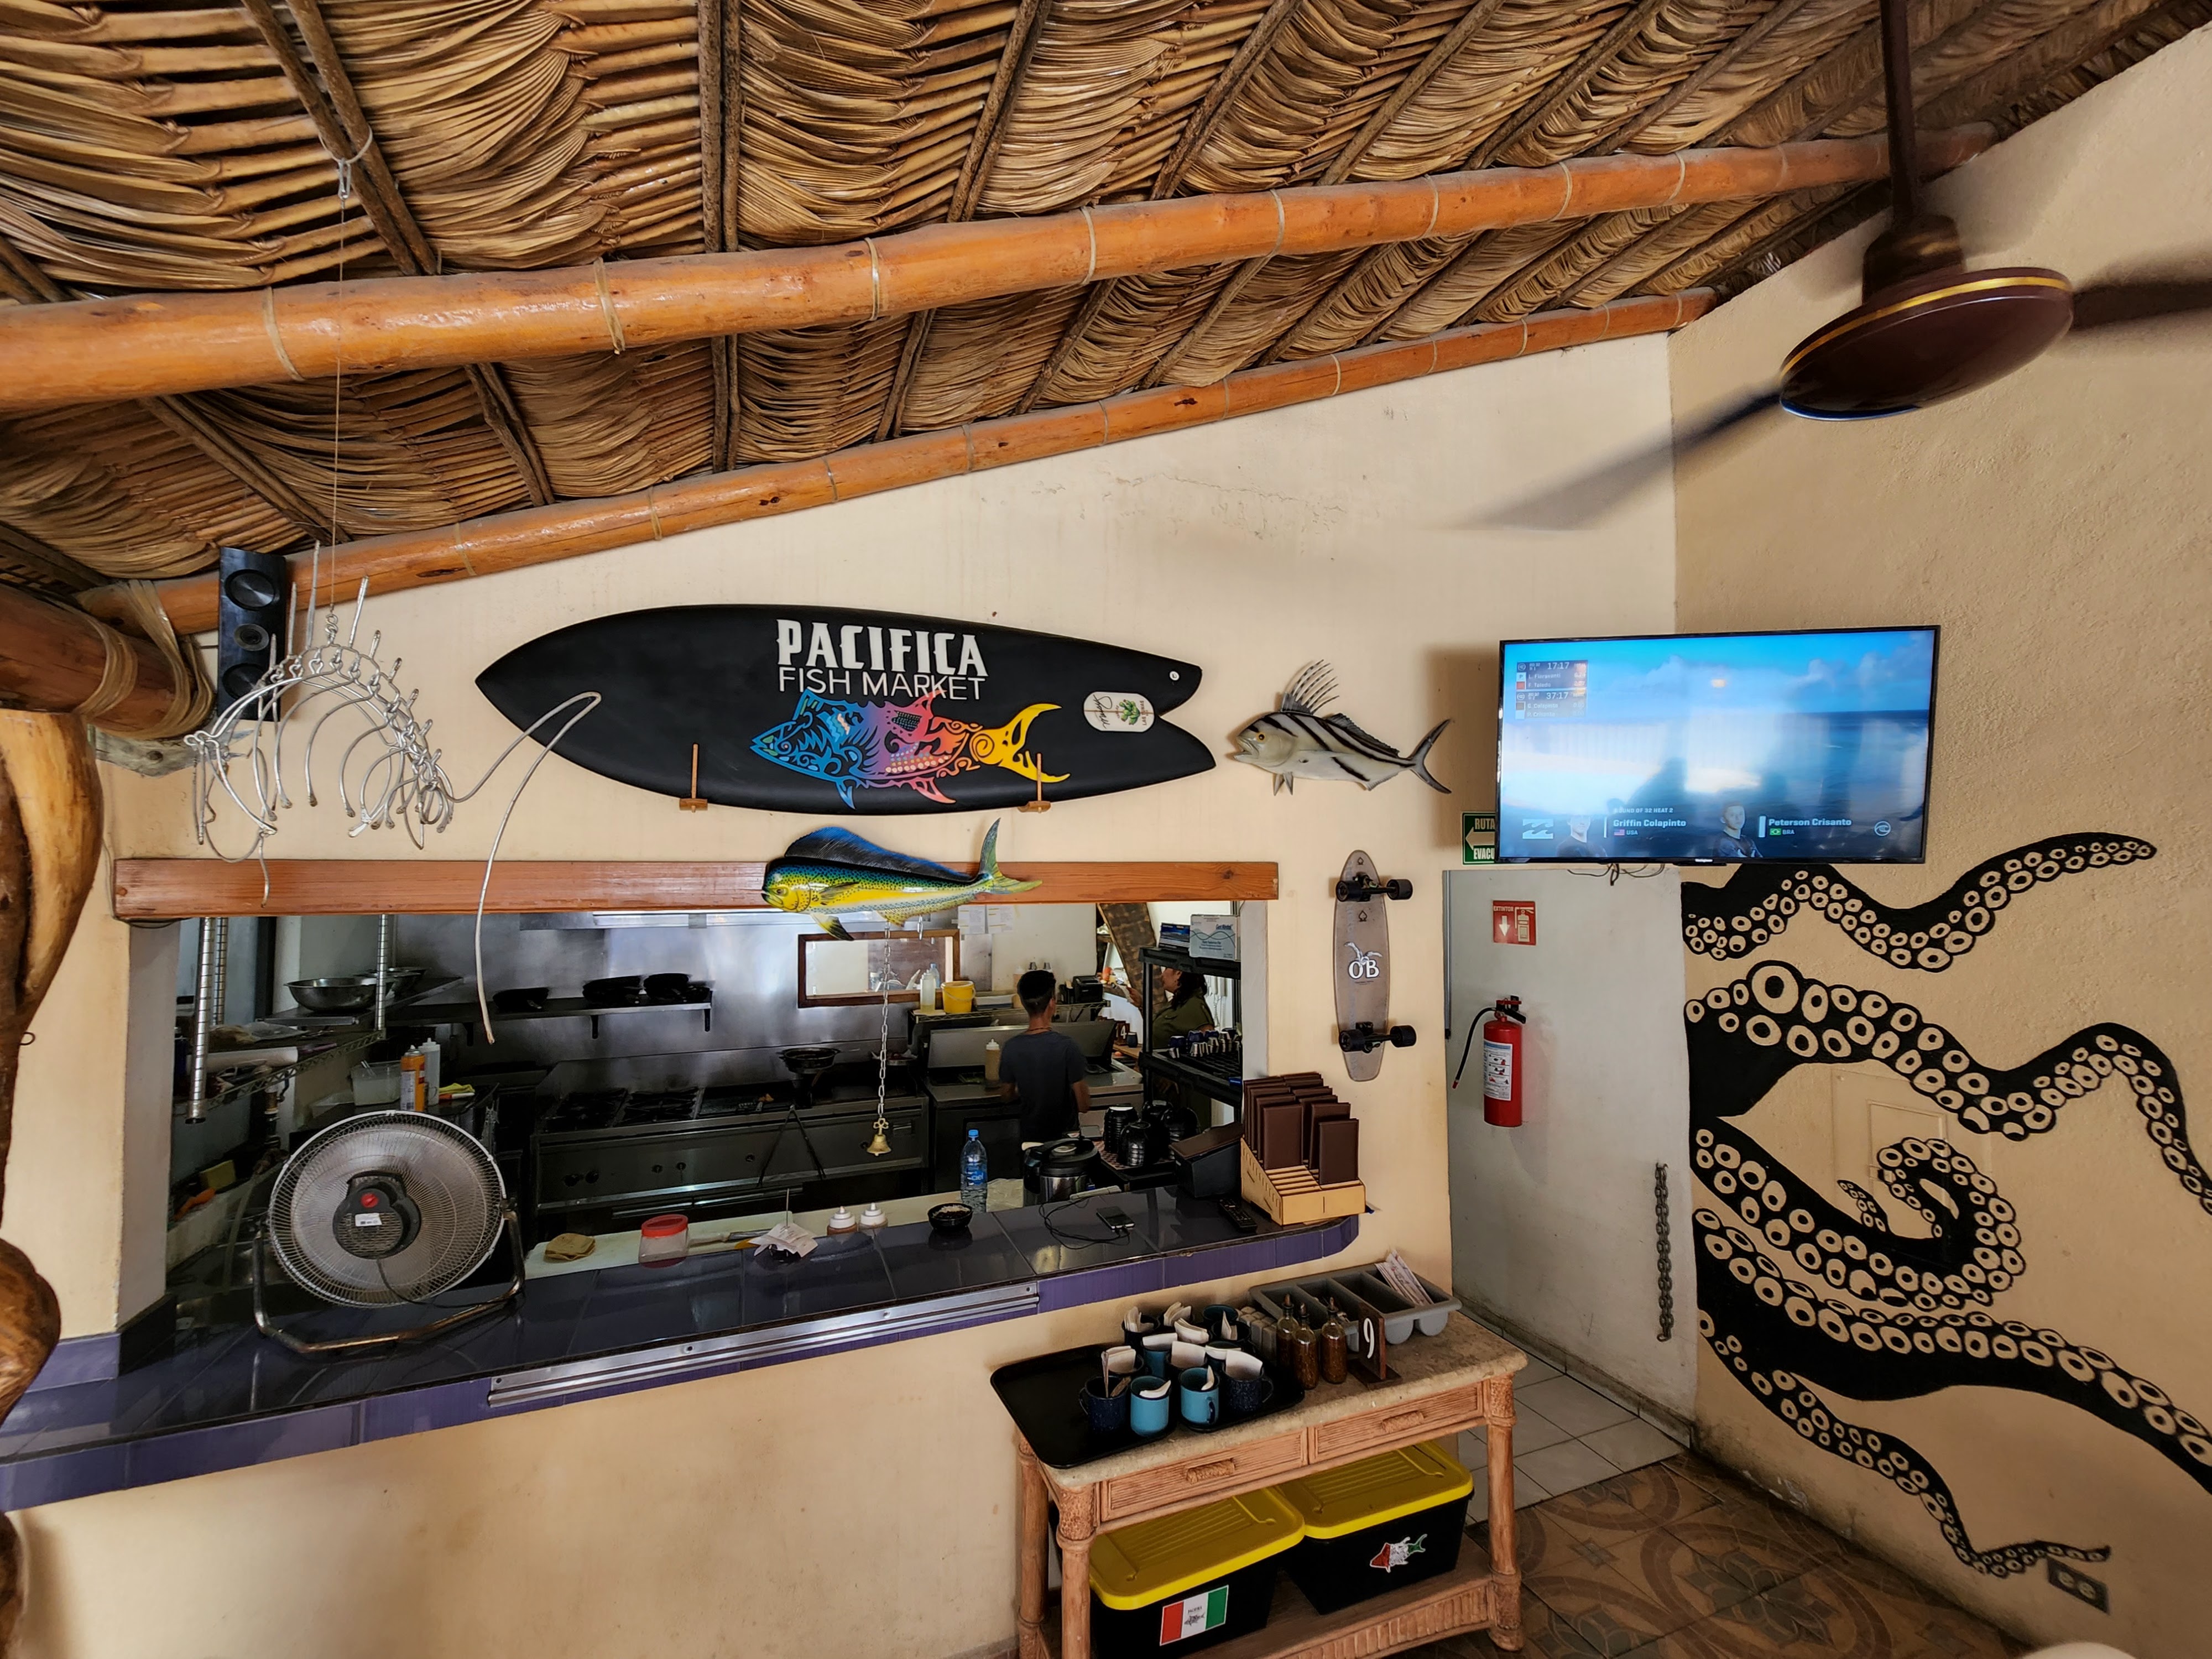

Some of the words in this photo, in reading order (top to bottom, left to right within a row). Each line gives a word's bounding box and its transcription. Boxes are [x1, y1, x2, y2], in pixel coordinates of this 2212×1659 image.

[776, 619, 989, 676] PACIFICA
[779, 667, 851, 695] FISH
[862, 671, 985, 701] MARKET
[1475, 818, 1495, 830] RUTA
[1644, 819, 1686, 828] Colapinto
[1348, 959, 1380, 980] OB
[1363, 1317, 1375, 1359] 9
